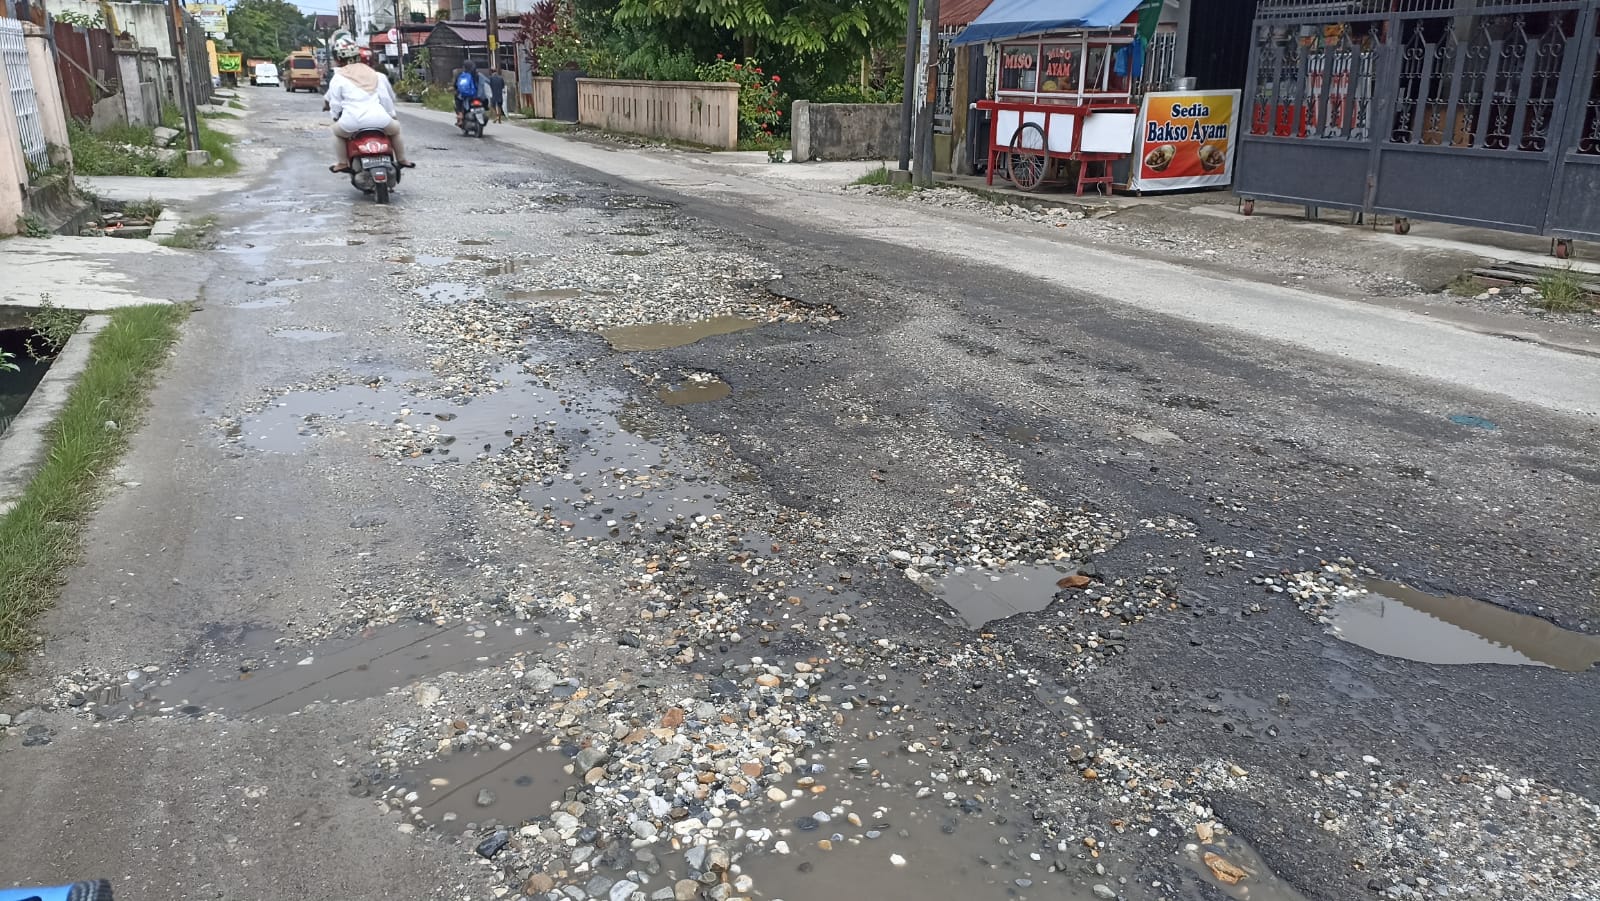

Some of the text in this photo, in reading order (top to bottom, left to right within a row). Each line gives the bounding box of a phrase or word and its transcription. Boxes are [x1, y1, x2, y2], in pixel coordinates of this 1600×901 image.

[1005, 53, 1032, 68] MISO
[1047, 48, 1071, 60] MISO
[1046, 63, 1071, 76] AYAM
[1171, 103, 1209, 118] Sedia
[1146, 120, 1227, 144] Bakso Ayam
